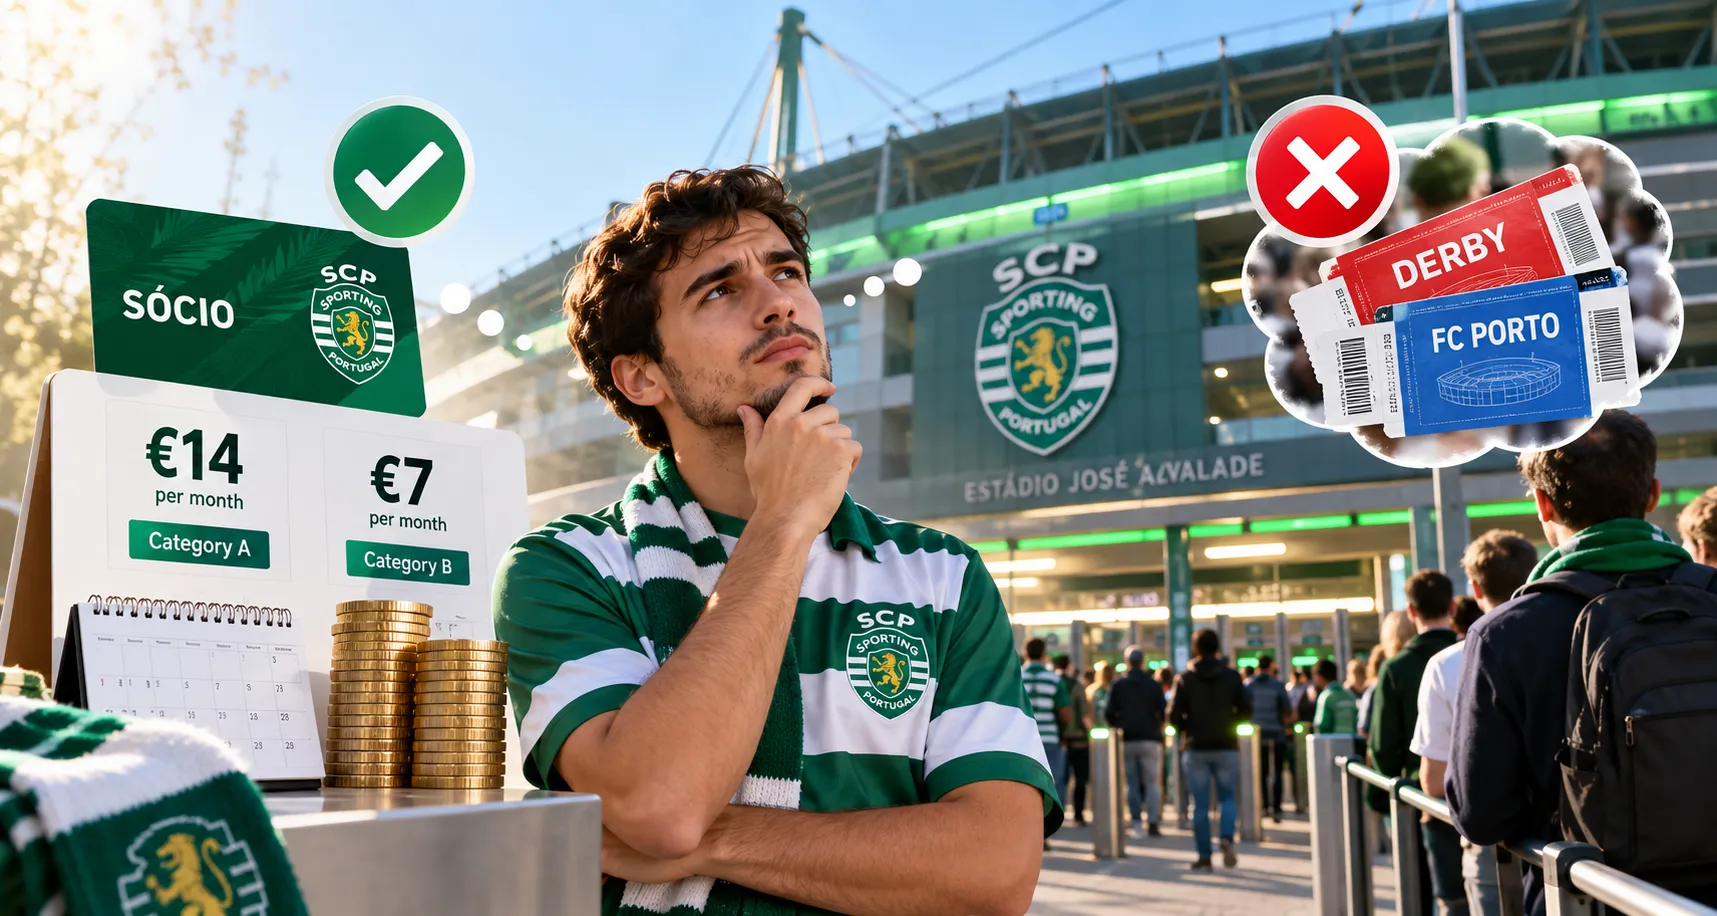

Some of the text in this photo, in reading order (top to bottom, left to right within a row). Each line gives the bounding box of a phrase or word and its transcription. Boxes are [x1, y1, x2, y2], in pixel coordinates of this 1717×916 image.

[992, 243, 1098, 293] SCP
[1391, 222, 1506, 290] DERBY
[320, 264, 377, 285] SCP
[122, 284, 235, 330] SÓCIO
[320, 290, 382, 316] SPORTING
[990, 289, 1099, 340] SPORTING
[1432, 324, 1464, 354] FC
[1471, 312, 1560, 350] PORTO
[328, 351, 385, 373] PORTUGAL
[998, 398, 1093, 435] PORTUGAL
[145, 426, 244, 485] €14
[370, 454, 434, 506] €7
[964, 452, 1265, 503] ESTÁDIO JOSÉ ALVALADE
[155, 490, 245, 511] per month
[369, 512, 448, 532] per month
[148, 531, 252, 558] Category A
[363, 551, 453, 576] Category B
[856, 609, 916, 629] SCP
[856, 634, 919, 656] SPORTING
[862, 690, 917, 710] PORTUGAL
